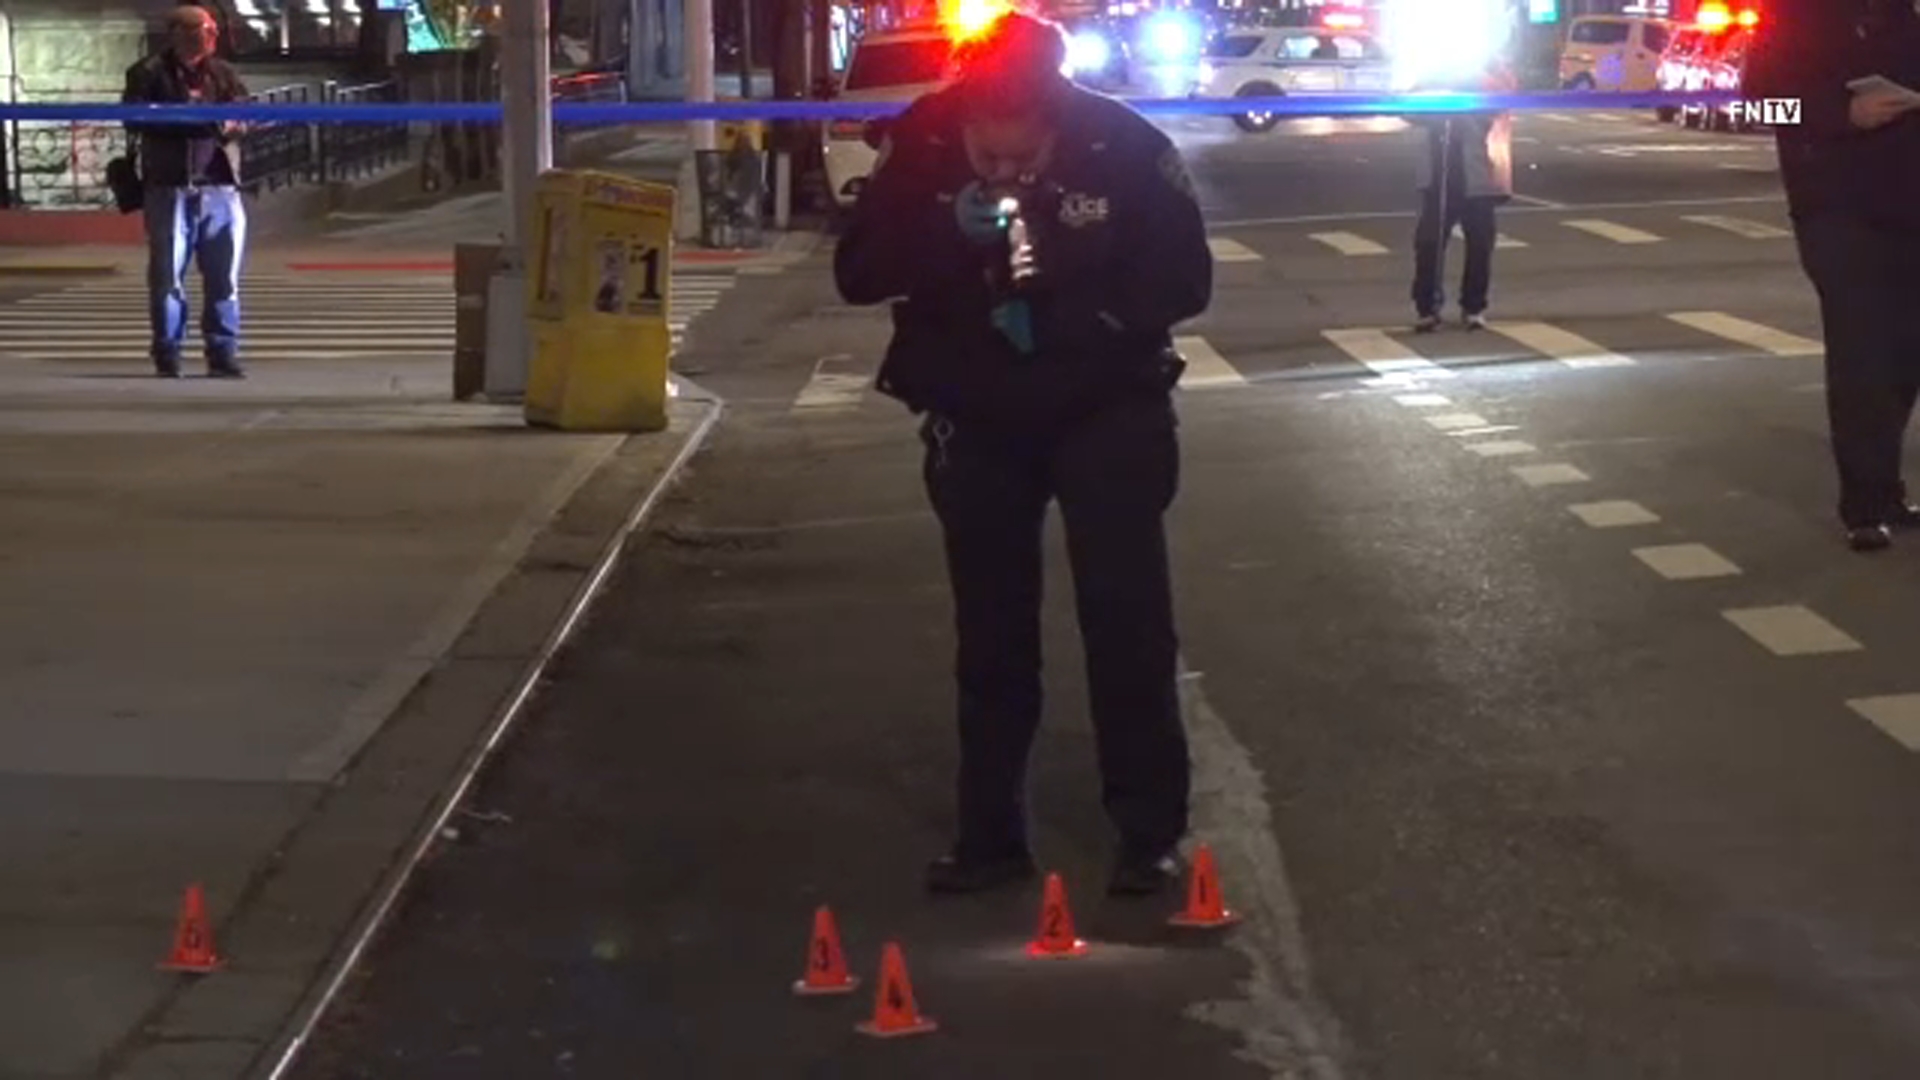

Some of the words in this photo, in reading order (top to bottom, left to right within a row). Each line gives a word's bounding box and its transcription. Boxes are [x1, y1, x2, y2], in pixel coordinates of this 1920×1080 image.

[639, 247, 663, 300] 1
[1197, 872, 1208, 906] 1
[1046, 902, 1063, 938] 2
[813, 935, 830, 972] 3
[886, 977, 905, 1010] 4
